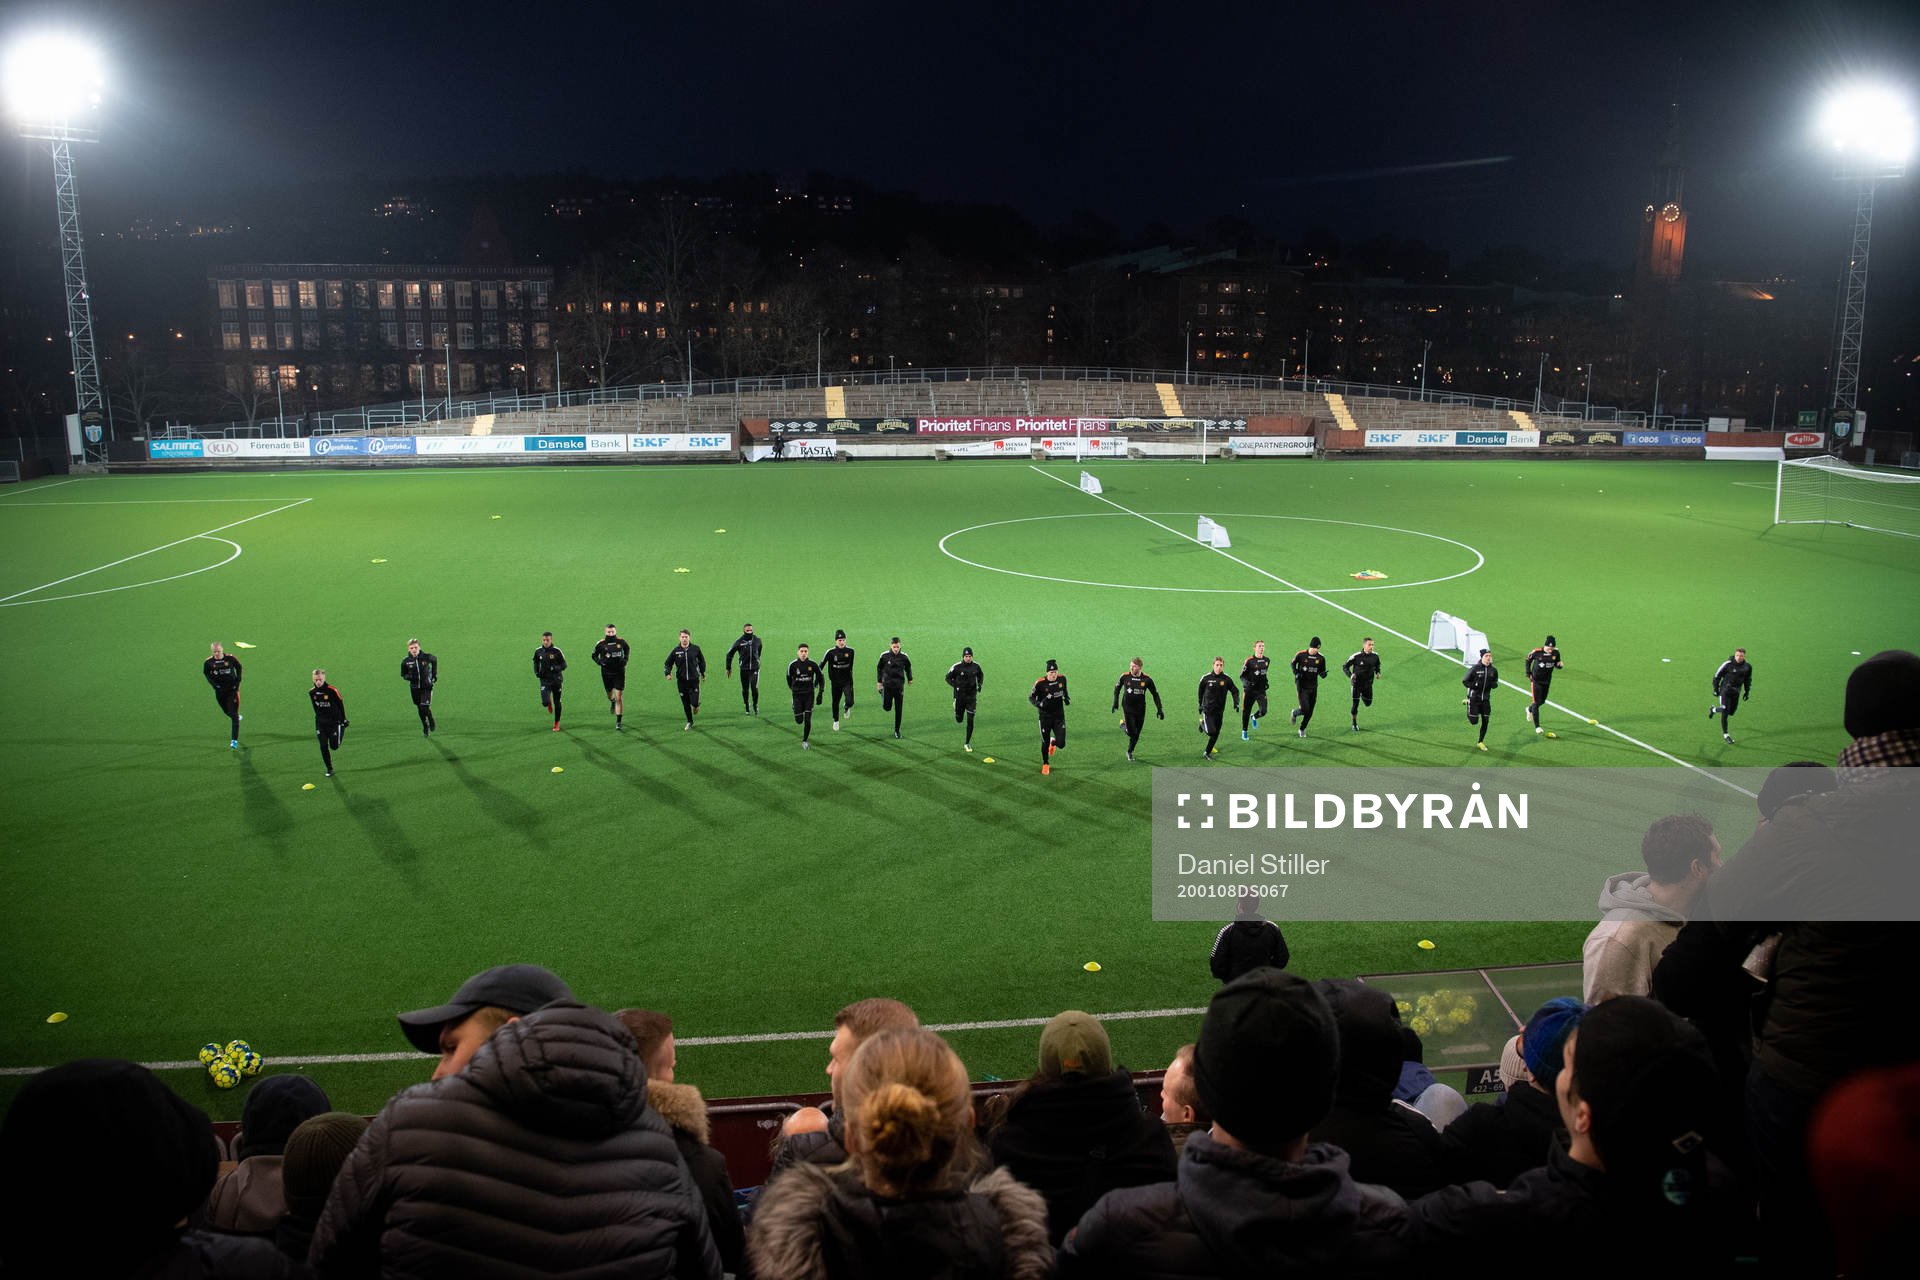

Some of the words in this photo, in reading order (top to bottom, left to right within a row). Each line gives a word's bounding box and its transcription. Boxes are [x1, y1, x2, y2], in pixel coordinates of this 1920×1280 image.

[919, 419, 971, 431] Prioritet
[973, 419, 1011, 431] Finans
[1015, 419, 1067, 431] Prioritet
[1069, 418, 1106, 430] Fnans
[633, 438, 670, 447] SKF
[689, 437, 726, 446] SKF
[1369, 433, 1401, 443] SKF
[1417, 433, 1449, 443] SKF
[1467, 434, 1505, 444] Danske
[1639, 436, 1659, 444] OBOS
[1681, 436, 1702, 444] OBOS
[212, 444, 234, 453] KIA
[250, 441, 291, 449] Förenade
[293, 441, 305, 449] Bil
[538, 439, 584, 449] Danske
[591, 439, 621, 448] Bank
[800, 446, 832, 455] RASTA
